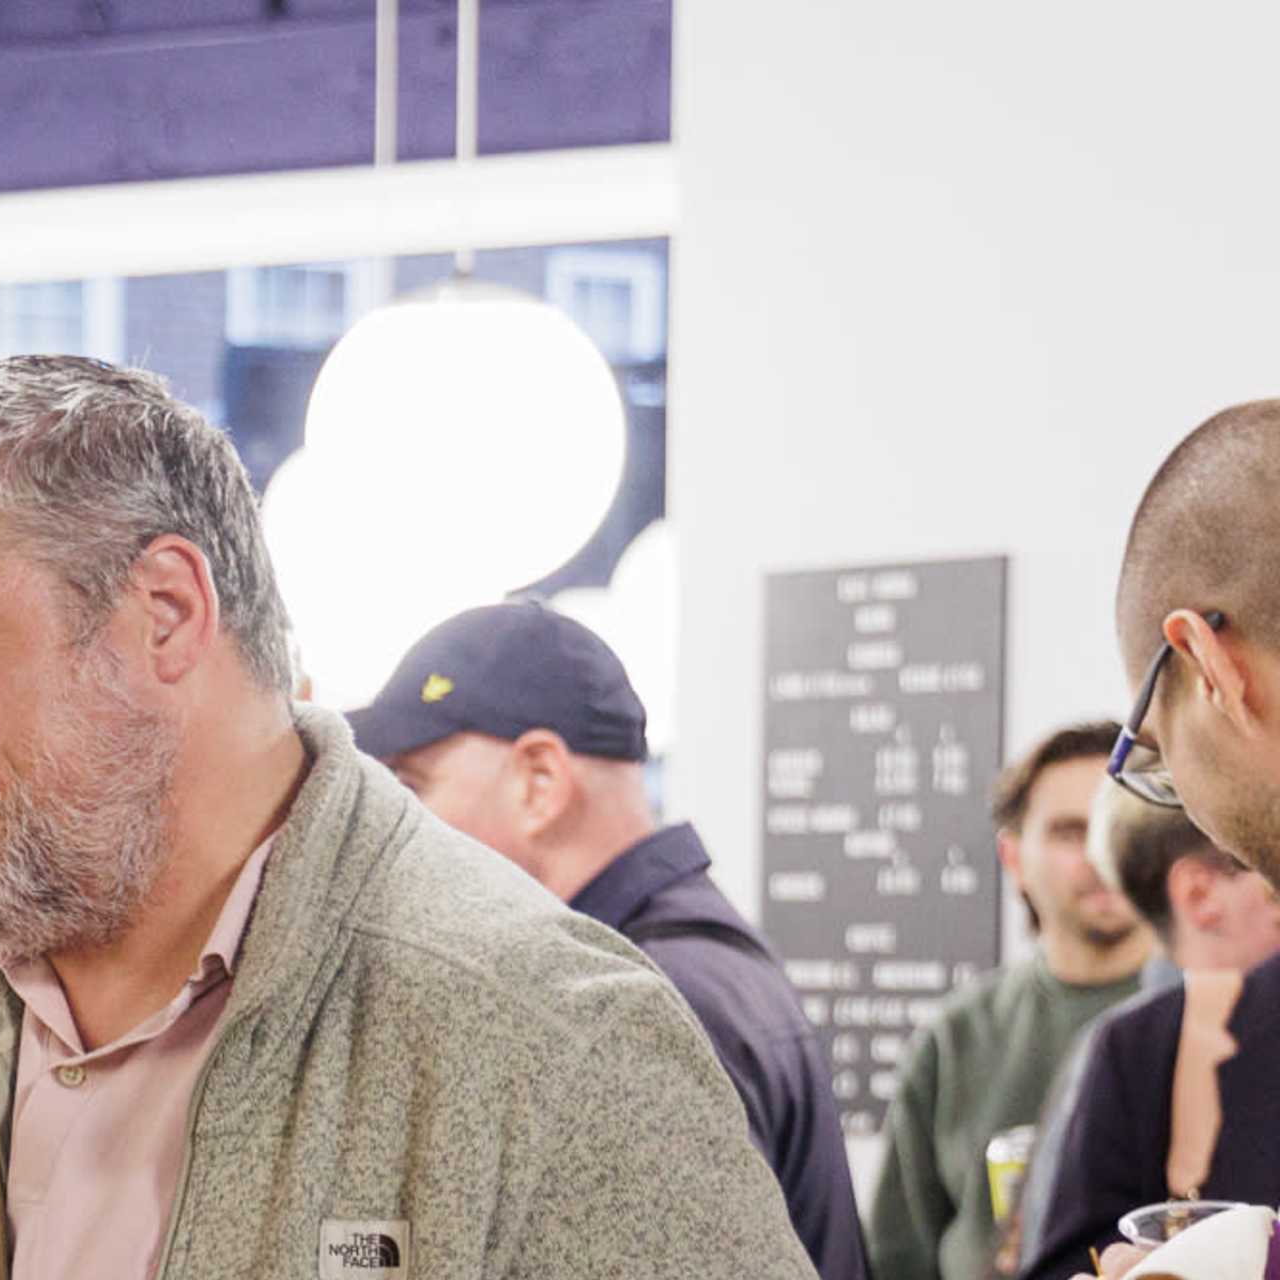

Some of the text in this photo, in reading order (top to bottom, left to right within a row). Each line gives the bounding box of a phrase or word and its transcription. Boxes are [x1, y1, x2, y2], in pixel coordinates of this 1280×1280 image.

[352, 1233, 378, 1246] THE
[329, 1244, 378, 1256] NORTH
[343, 1257, 378, 1267] FACE
